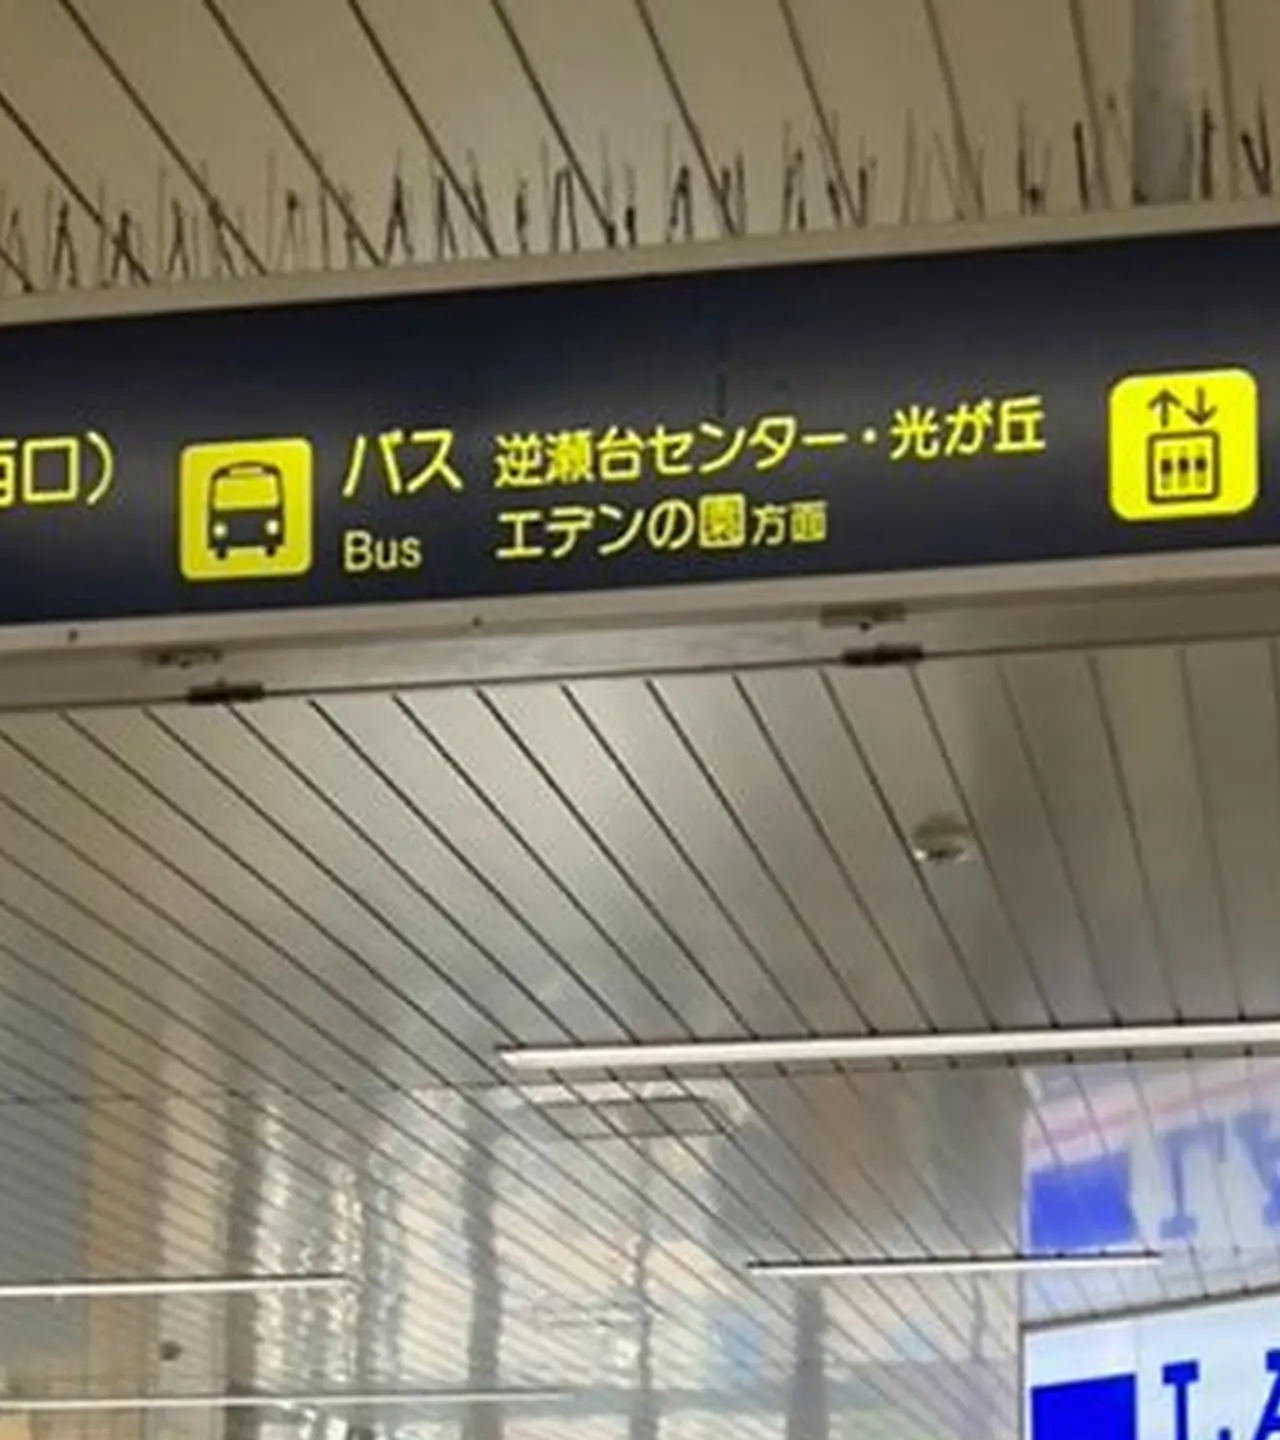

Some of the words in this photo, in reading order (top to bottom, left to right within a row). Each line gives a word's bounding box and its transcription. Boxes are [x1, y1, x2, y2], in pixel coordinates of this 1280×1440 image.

[342, 429, 465, 499] バス
[493, 395, 1049, 491] 逆瀬台センター・光が丘
[343, 529, 423, 574] Bus
